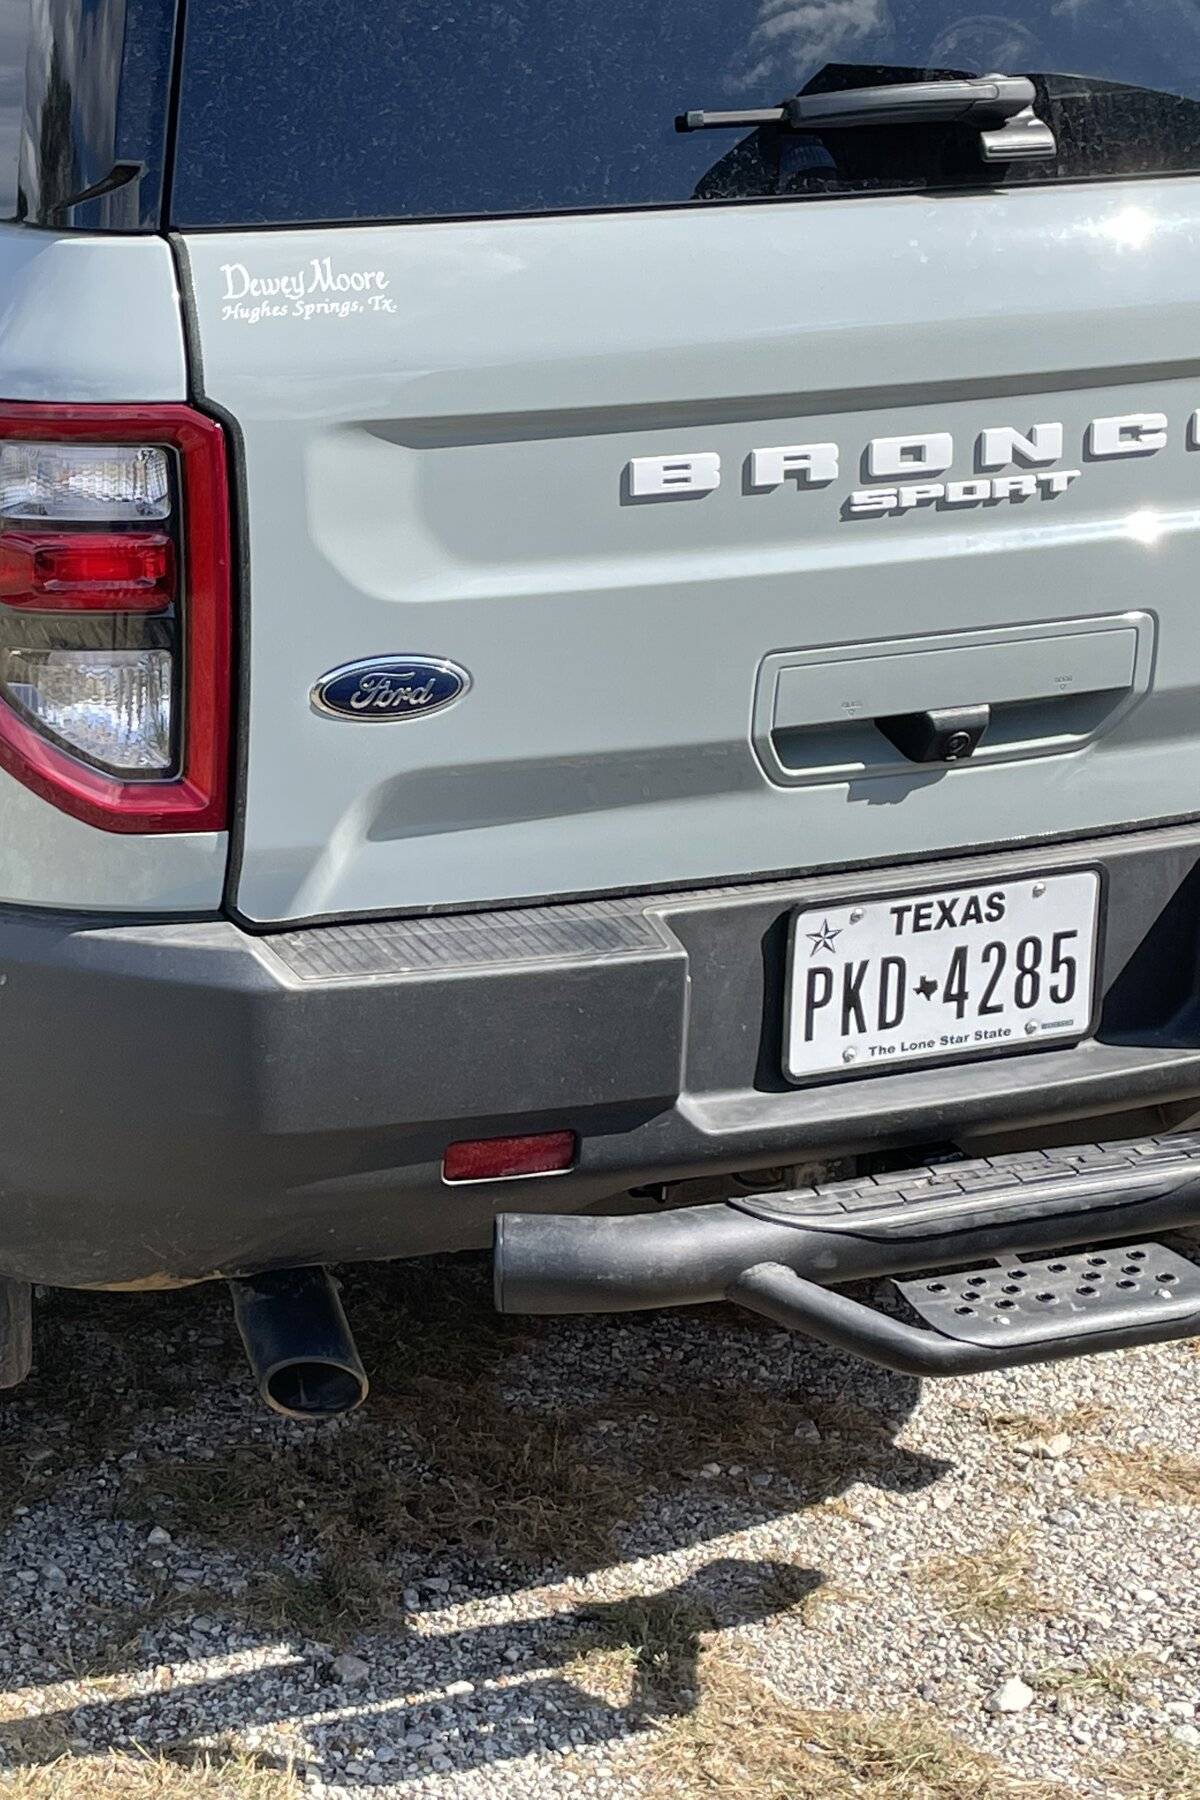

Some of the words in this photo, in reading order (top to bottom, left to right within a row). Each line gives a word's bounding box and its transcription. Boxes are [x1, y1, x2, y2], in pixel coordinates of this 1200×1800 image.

[219, 262, 304, 300] Dewey
[307, 256, 390, 294] Moore
[221, 300, 288, 324] Hughes
[624, 408, 1200, 500] BRONC
[846, 469, 1081, 515] SPORT
[350, 671, 437, 710] Ford
[890, 891, 1006, 936] TEXAS
[868, 1044, 896, 1057] The
[900, 1038, 936, 1052] Lone
[940, 1033, 970, 1046] Star
[974, 1027, 1012, 1042] State
